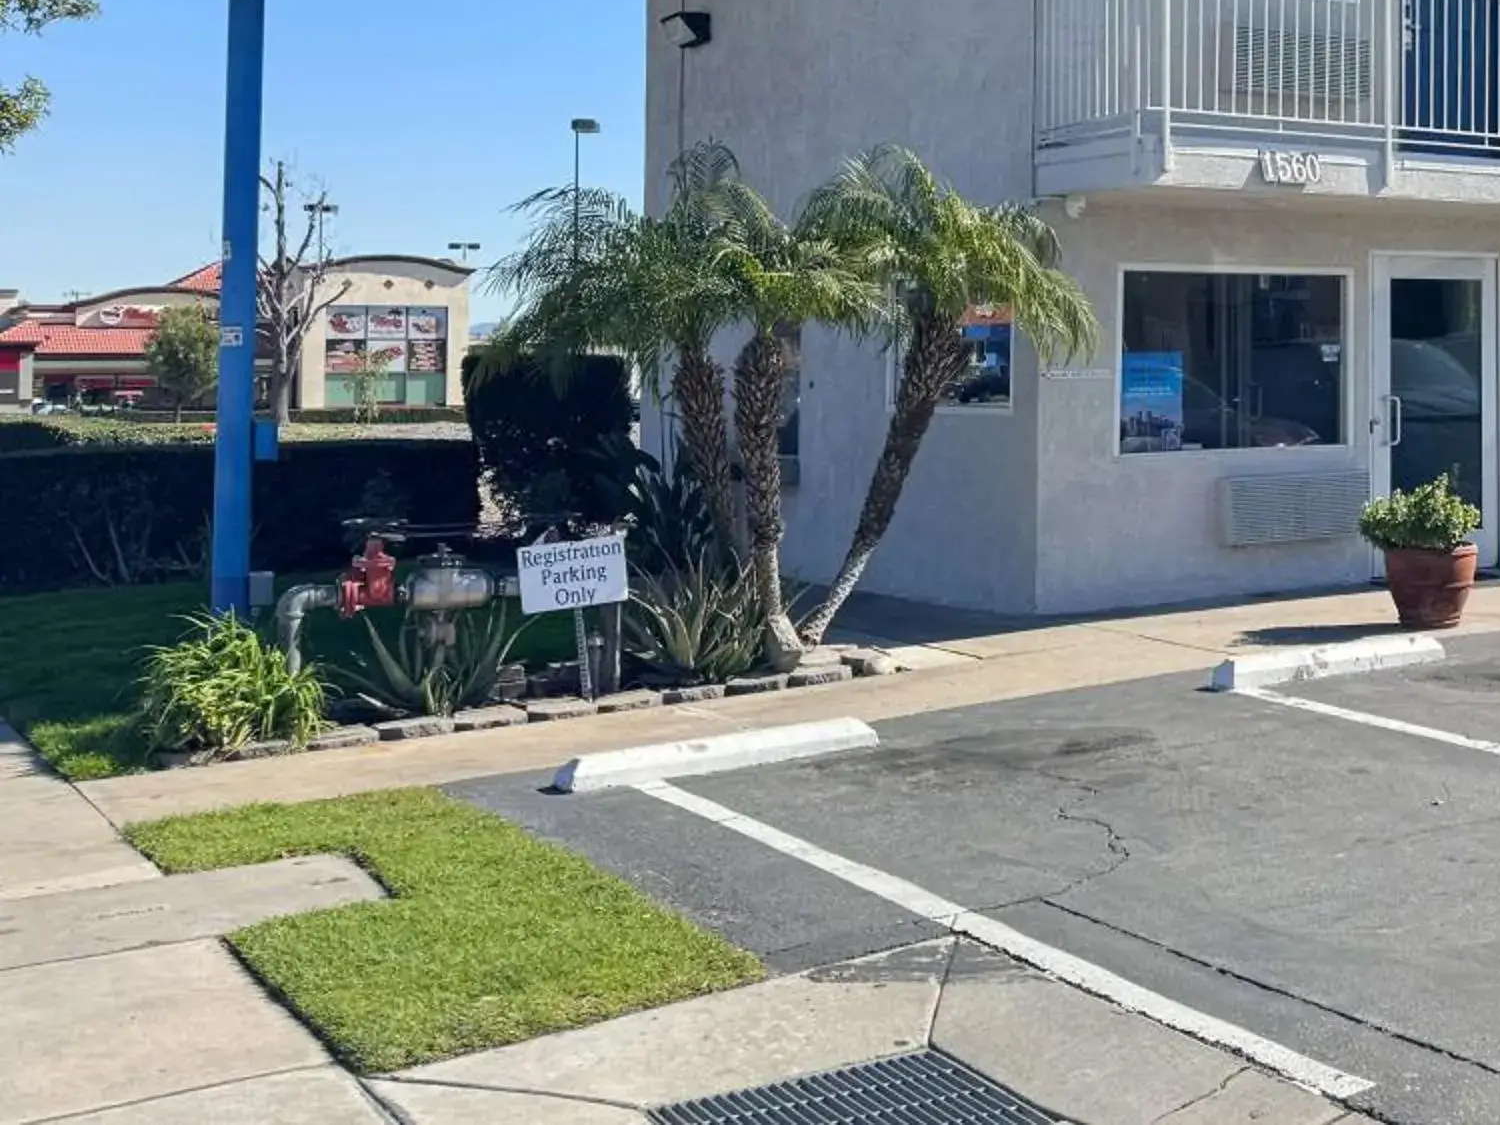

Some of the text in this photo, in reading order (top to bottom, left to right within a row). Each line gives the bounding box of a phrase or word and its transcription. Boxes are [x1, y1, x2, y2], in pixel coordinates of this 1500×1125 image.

[1260, 150, 1321, 184] 1560
[521, 541, 622, 569] Registration
[541, 564, 608, 586] Parking
[555, 586, 596, 606] Only
